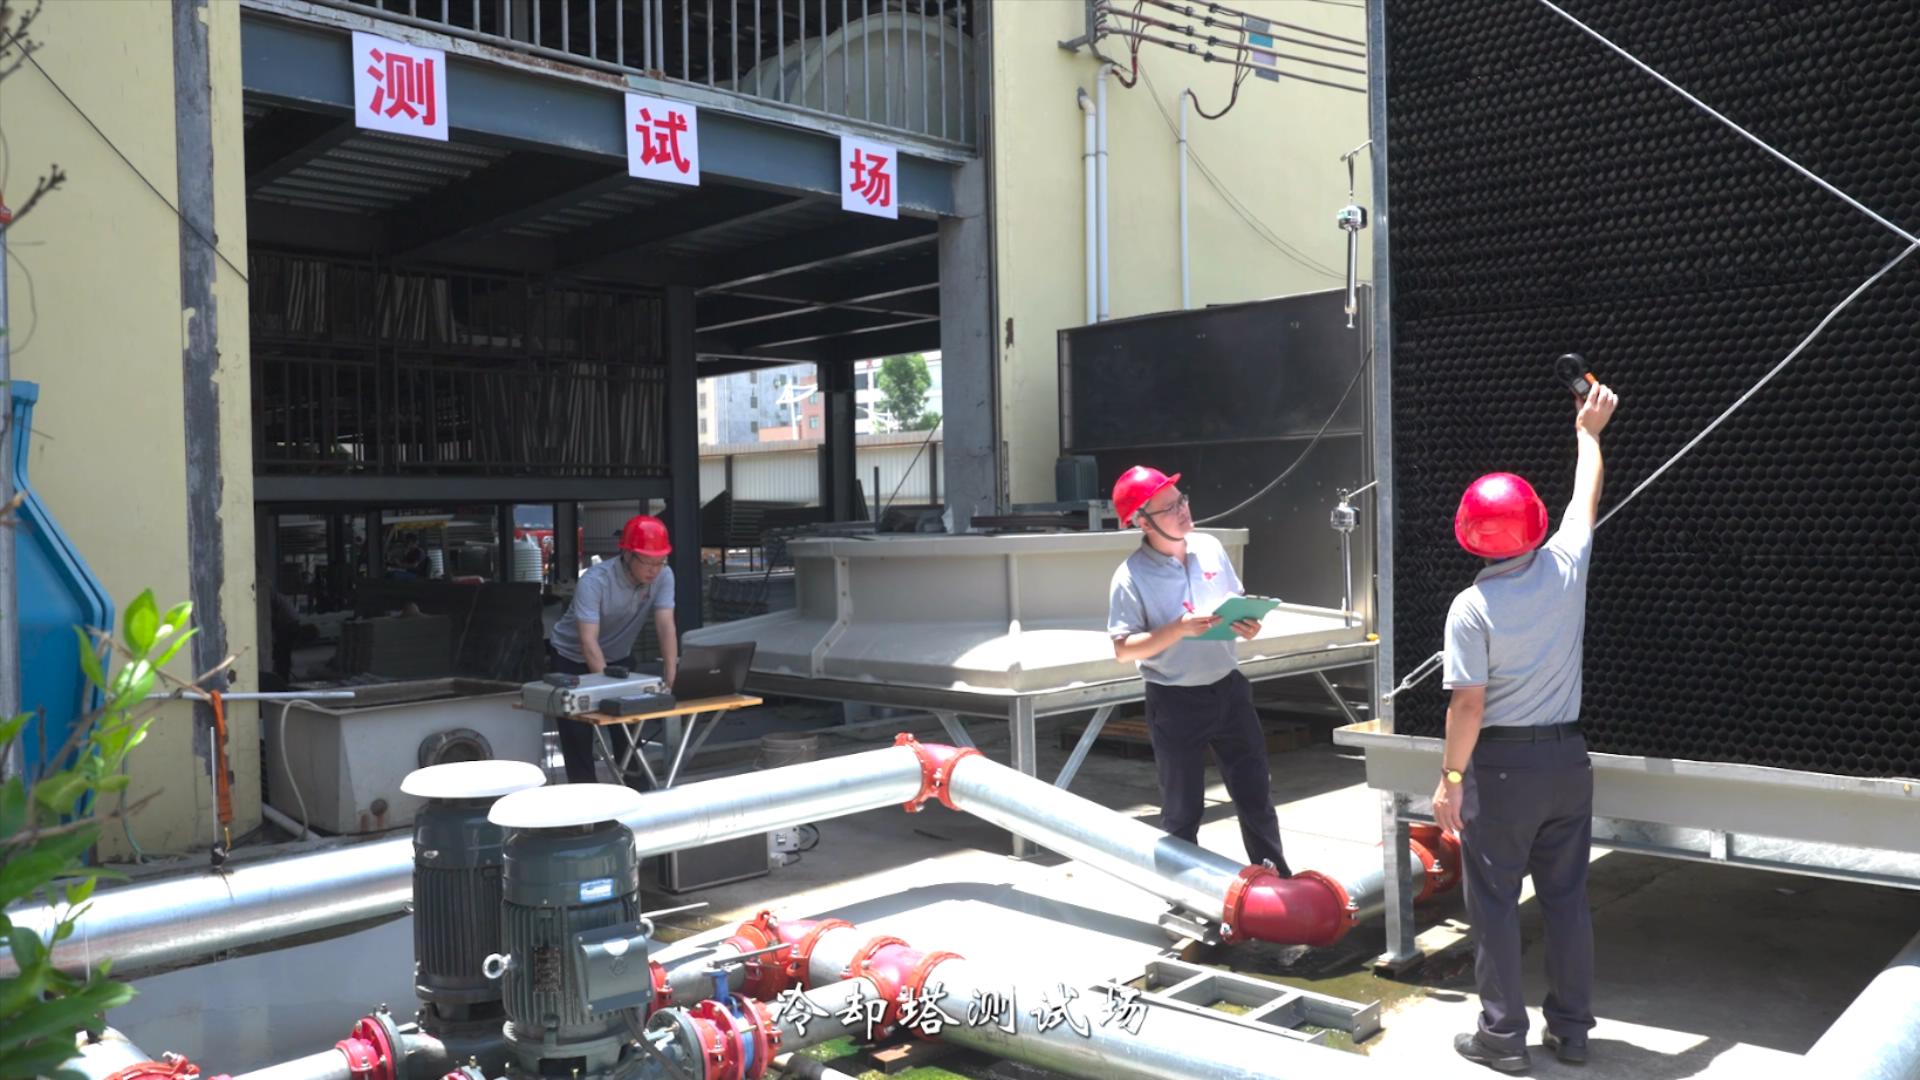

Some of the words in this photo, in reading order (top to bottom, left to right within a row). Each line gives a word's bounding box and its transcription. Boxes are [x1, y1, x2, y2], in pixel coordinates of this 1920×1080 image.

[367, 48, 437, 126] 测
[634, 107, 691, 174] 试
[849, 148, 892, 208] 场
